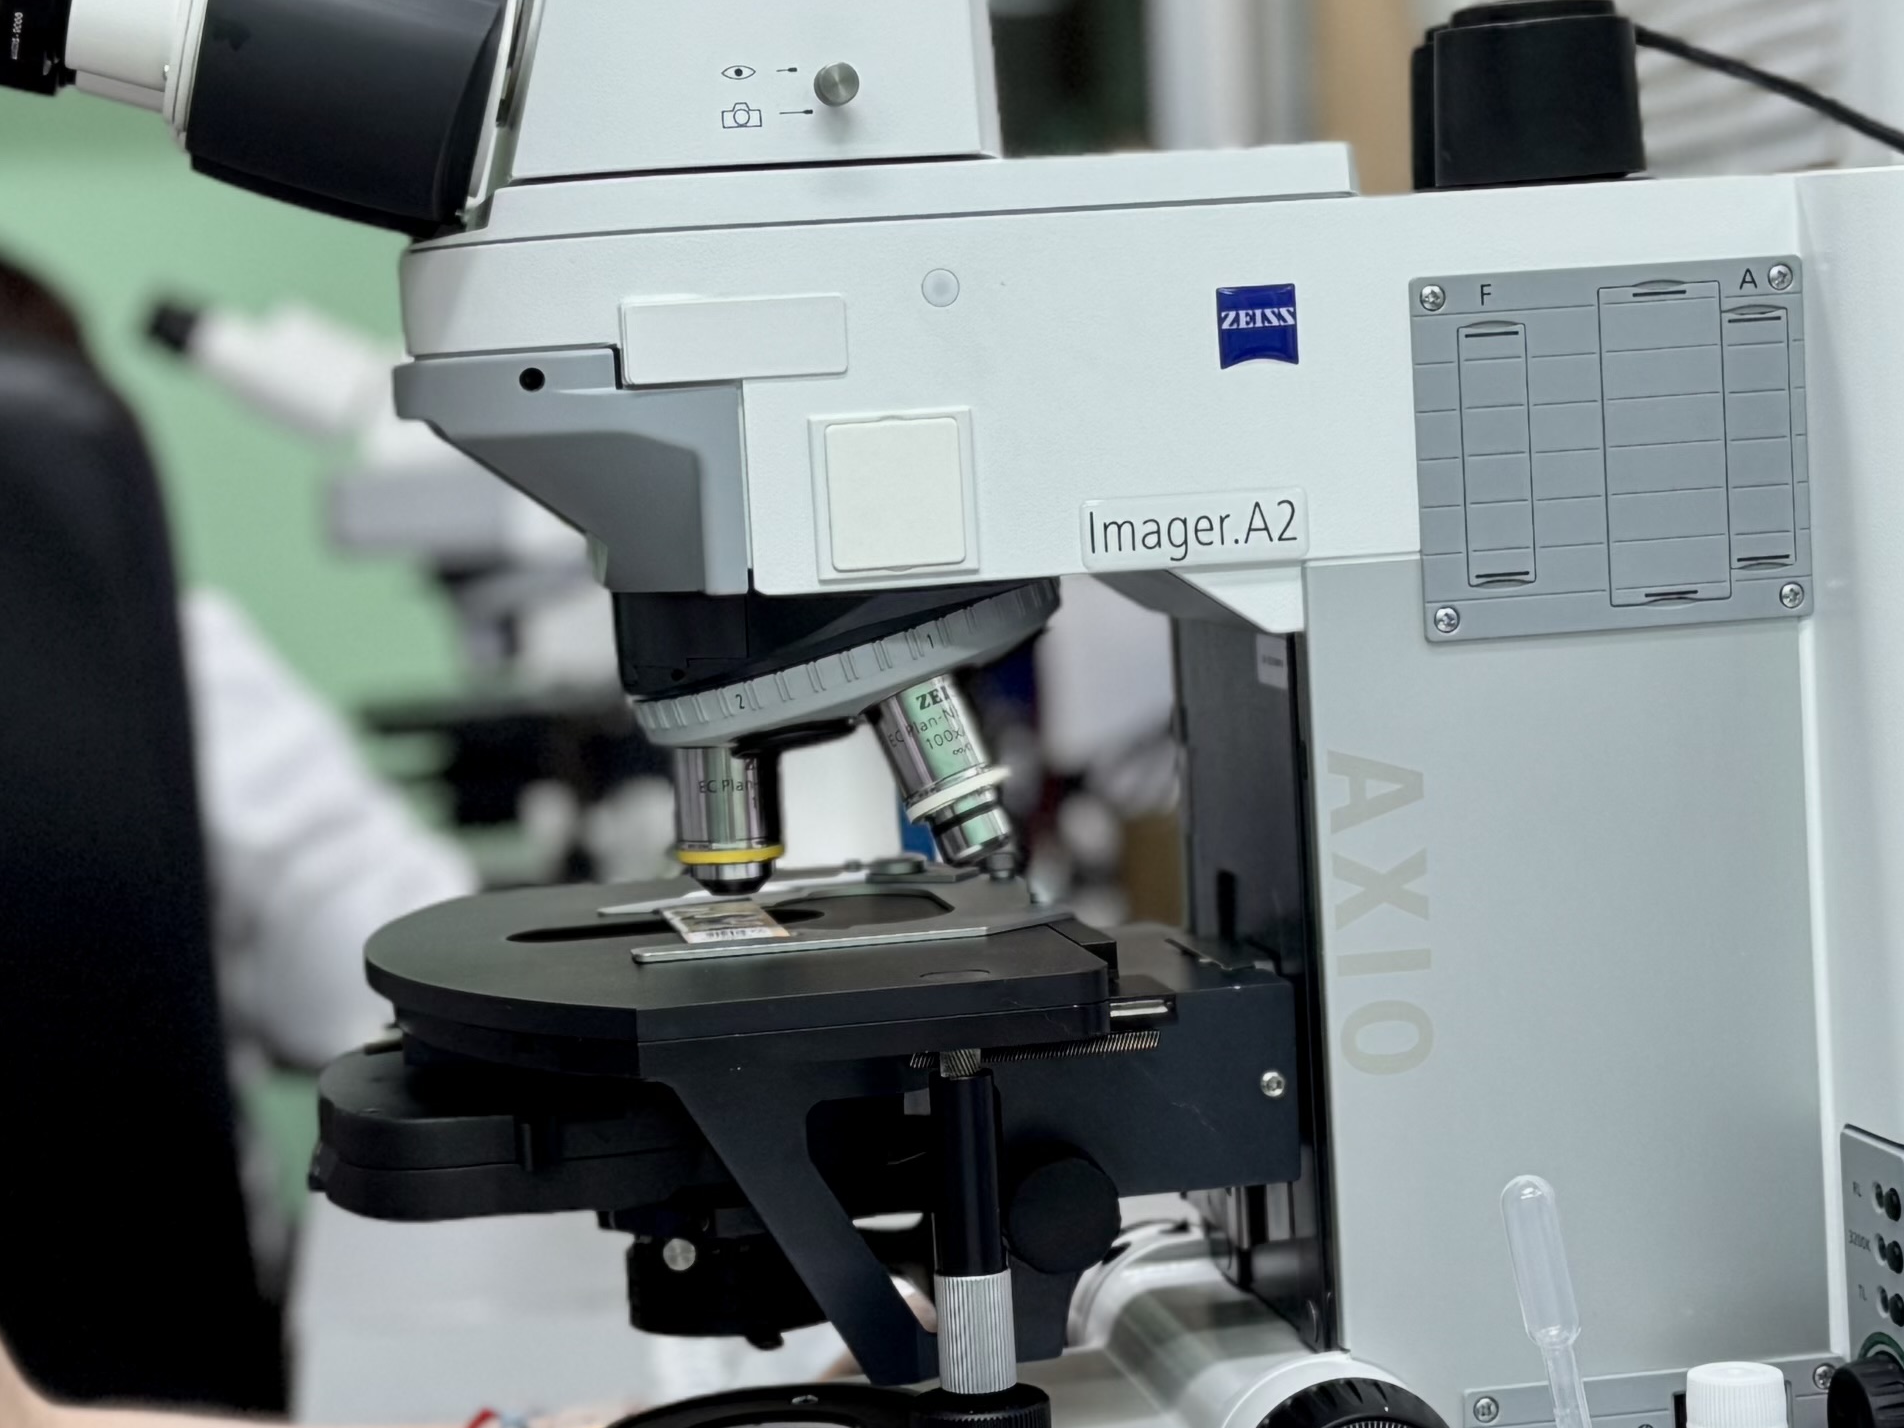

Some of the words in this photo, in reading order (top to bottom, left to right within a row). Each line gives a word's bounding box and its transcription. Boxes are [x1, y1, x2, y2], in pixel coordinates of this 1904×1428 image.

[1739, 267, 1758, 291] A
[1479, 282, 1493, 307] F
[1220, 307, 1296, 330] ZEISS
[1089, 499, 1298, 562] Imager.A2
[735, 693, 745, 710] 2
[1325, 747, 1437, 1077] AXIO
